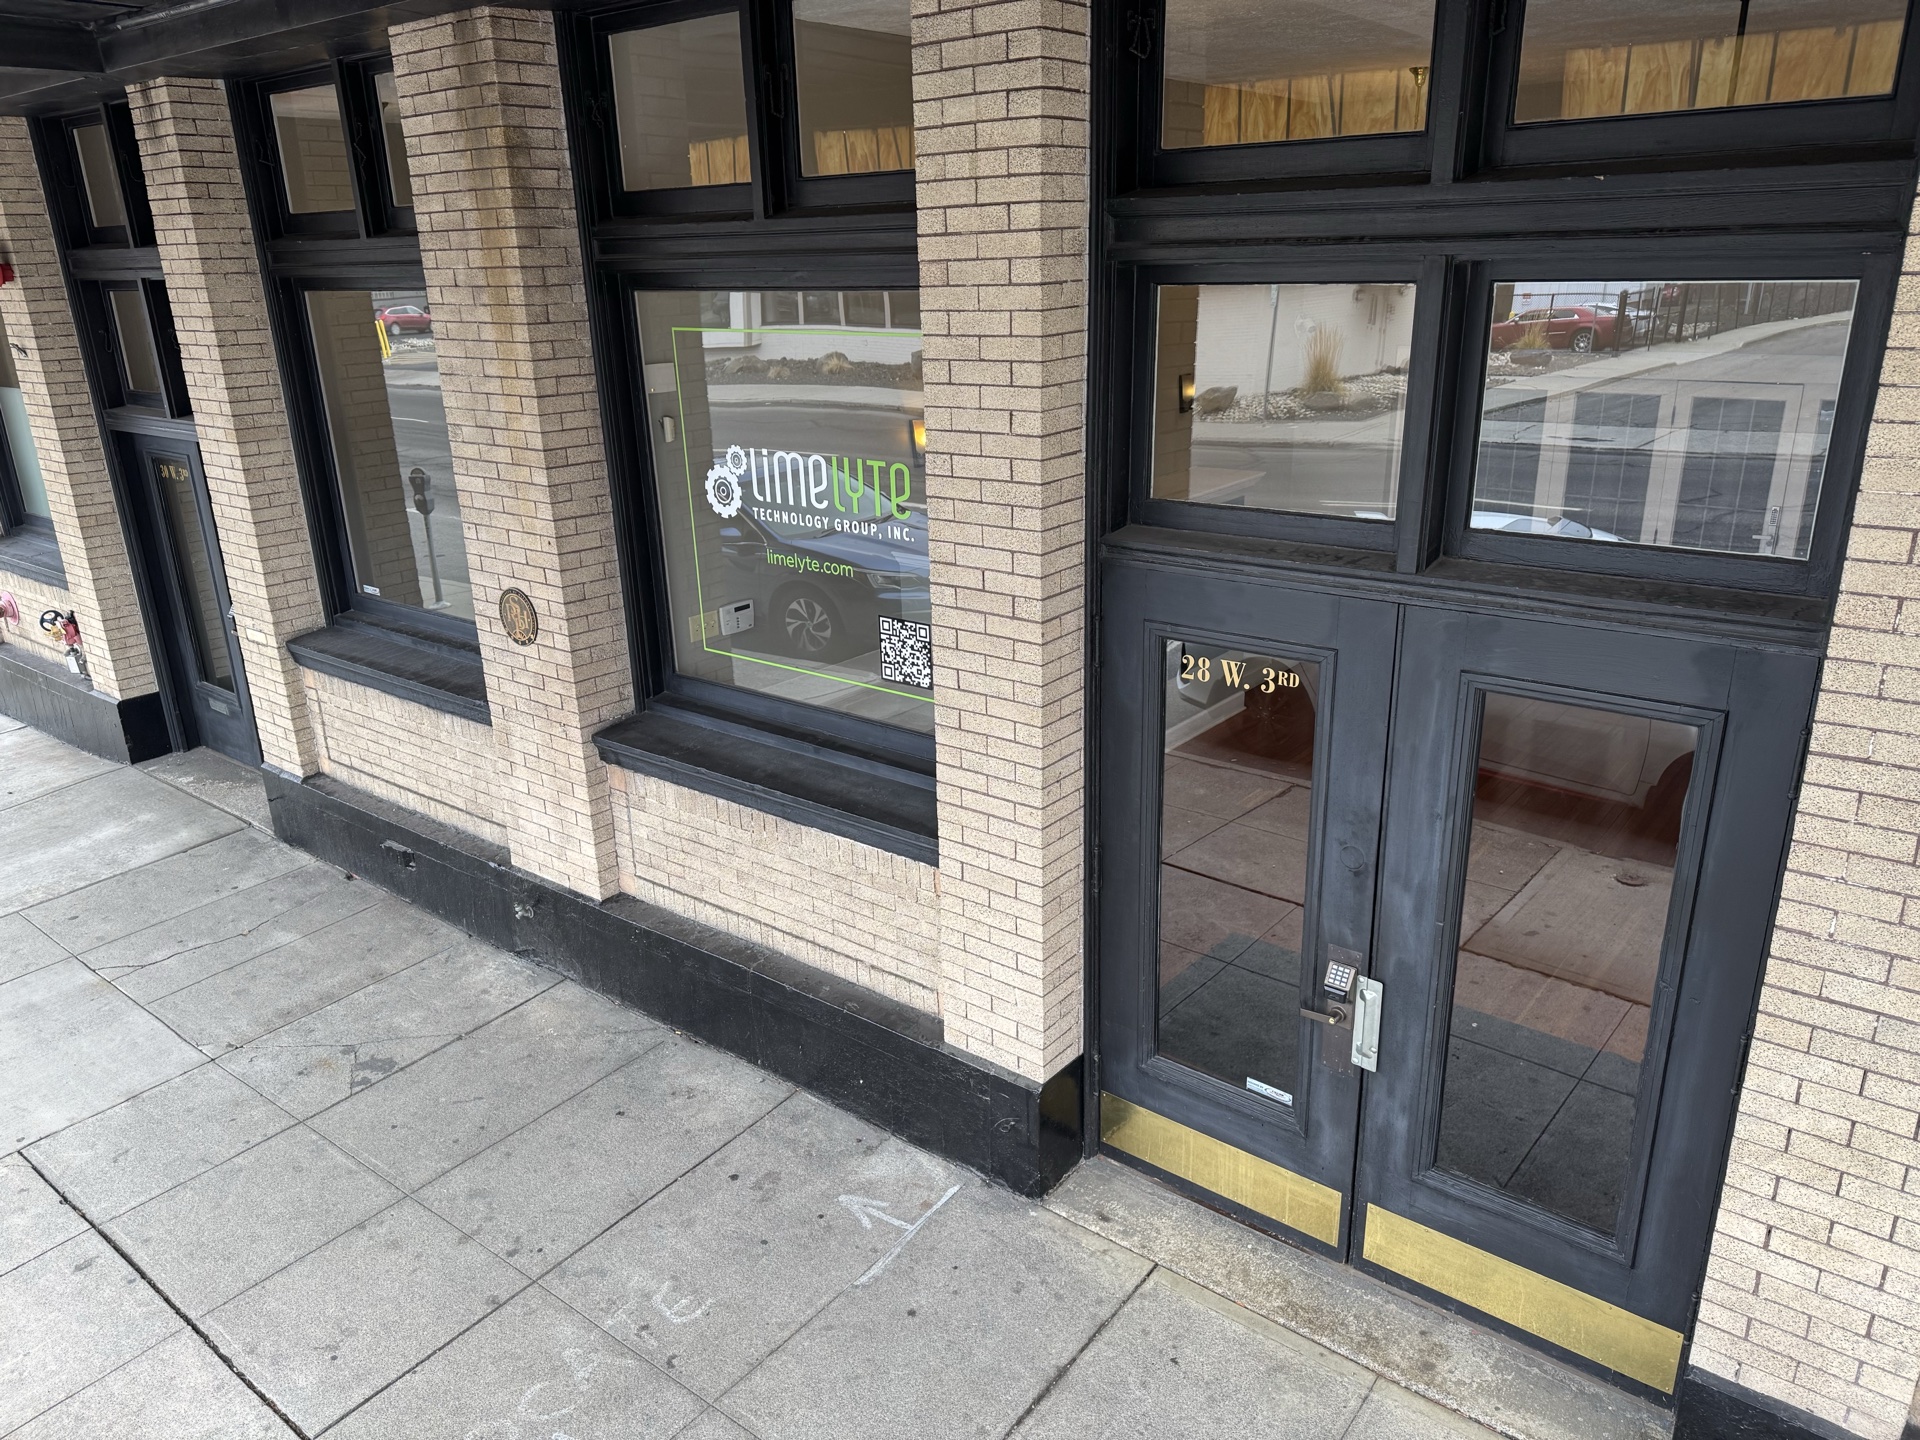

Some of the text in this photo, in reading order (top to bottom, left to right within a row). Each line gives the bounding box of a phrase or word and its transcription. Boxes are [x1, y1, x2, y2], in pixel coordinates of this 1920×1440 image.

[160, 464, 169, 479] 30
[752, 506, 915, 543] TECHNOLOGY GROUP, INC.
[766, 548, 854, 578] limelyte.com
[1181, 654, 1300, 694] 28 W. 3RD
